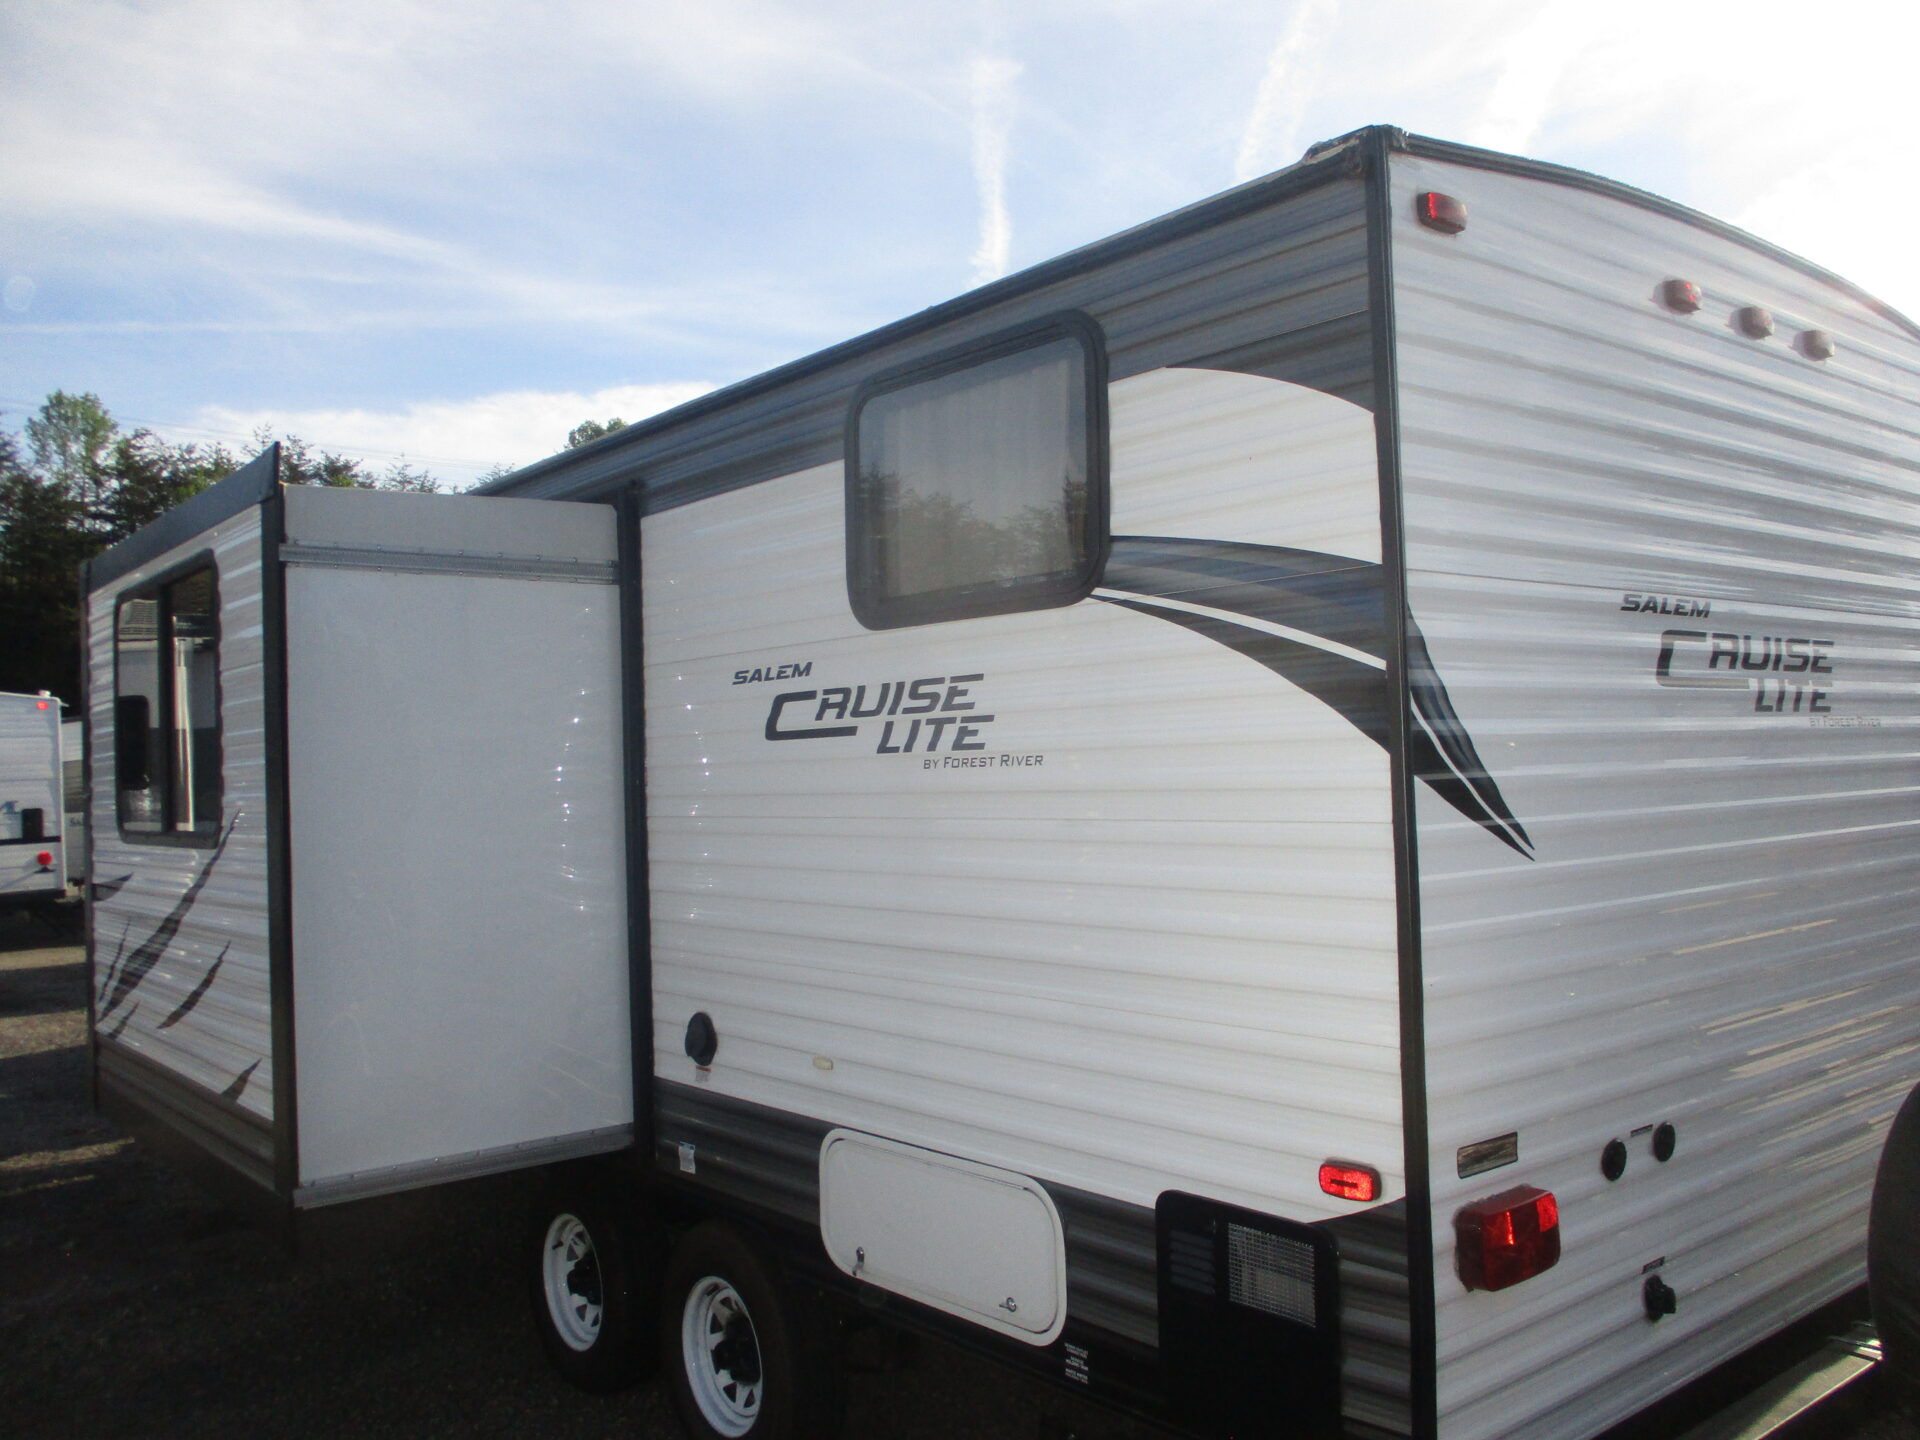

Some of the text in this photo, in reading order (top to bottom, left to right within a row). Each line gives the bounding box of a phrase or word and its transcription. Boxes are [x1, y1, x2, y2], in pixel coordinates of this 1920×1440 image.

[1620, 593, 1711, 618] SALEM
[732, 661, 813, 685] SALEM
[1655, 629, 1835, 690] CRUISE
[765, 673, 984, 741] CRUISE
[1754, 678, 1833, 713] LITE
[876, 714, 995, 754] LITE
[923, 754, 1044, 770] BY FOREST RIVER
